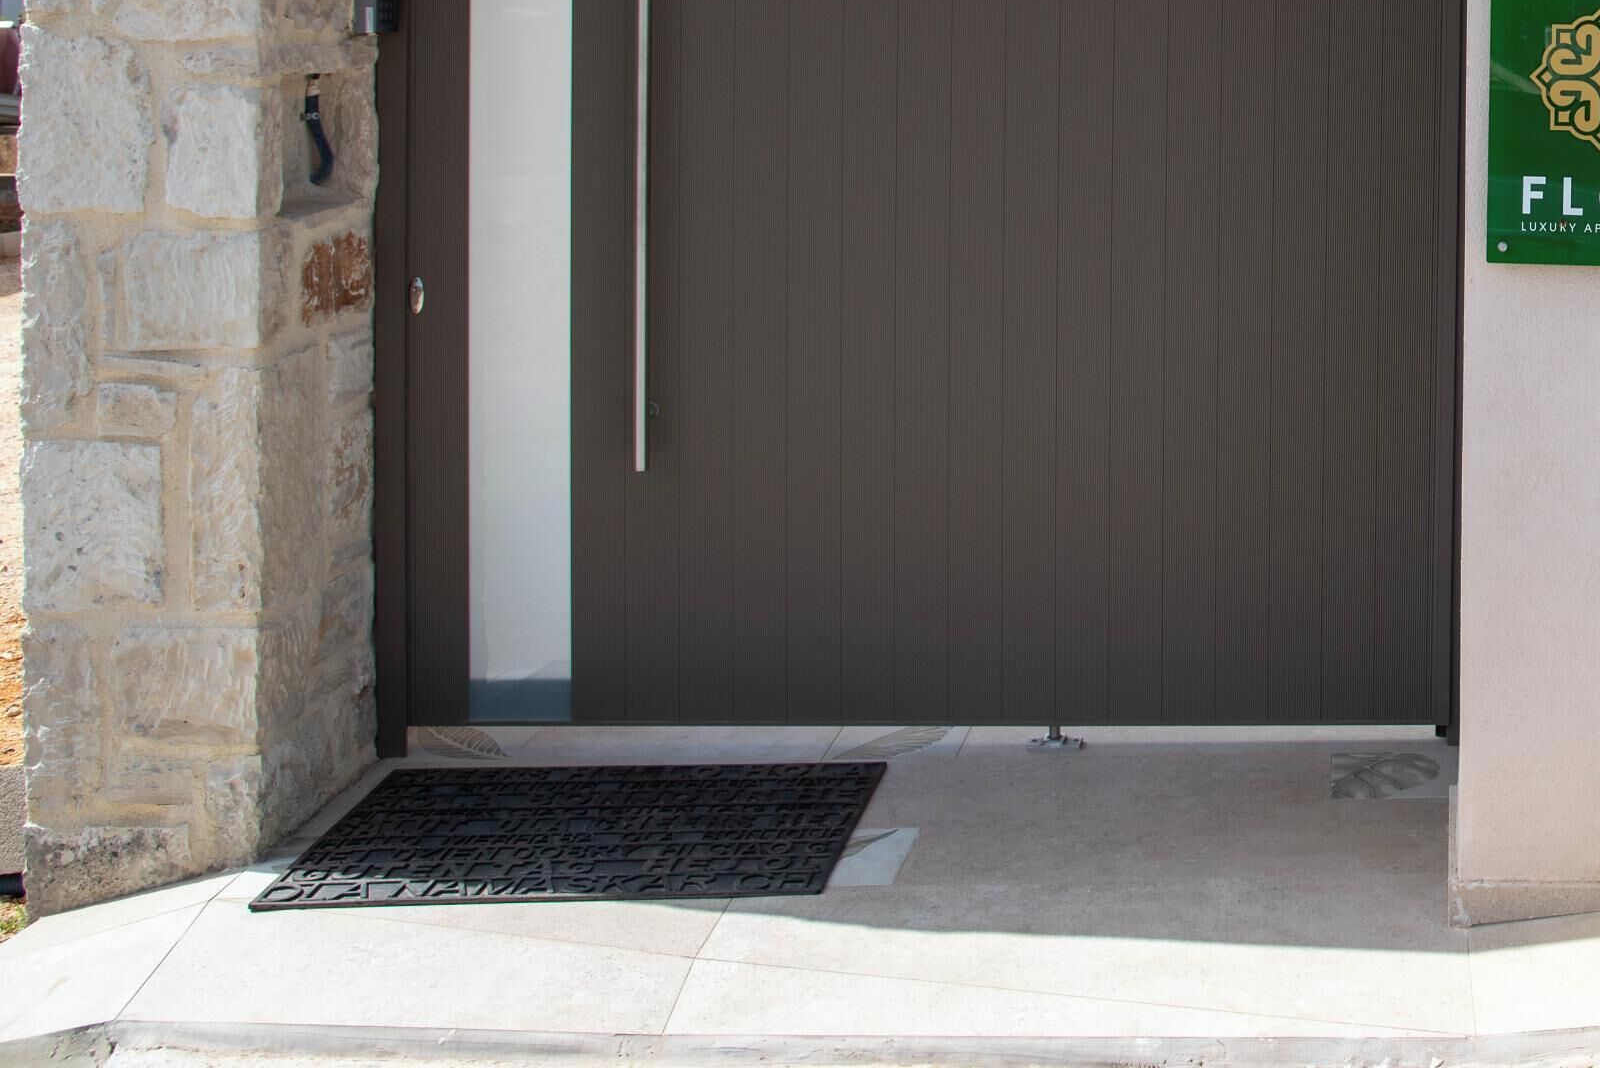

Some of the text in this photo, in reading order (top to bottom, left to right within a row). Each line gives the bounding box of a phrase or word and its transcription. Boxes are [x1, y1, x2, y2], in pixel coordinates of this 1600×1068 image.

[1521, 221, 1577, 233] LUXURY
[745, 763, 867, 777] HOLA
[527, 790, 772, 806] BONJOUR
[390, 846, 503, 862] DZIEN
[511, 843, 642, 859] DOBRY
[706, 840, 795, 855] CIAO
[486, 860, 595, 877] TAG
[259, 882, 376, 901] OLA
[387, 873, 718, 899] NAMASKAR
